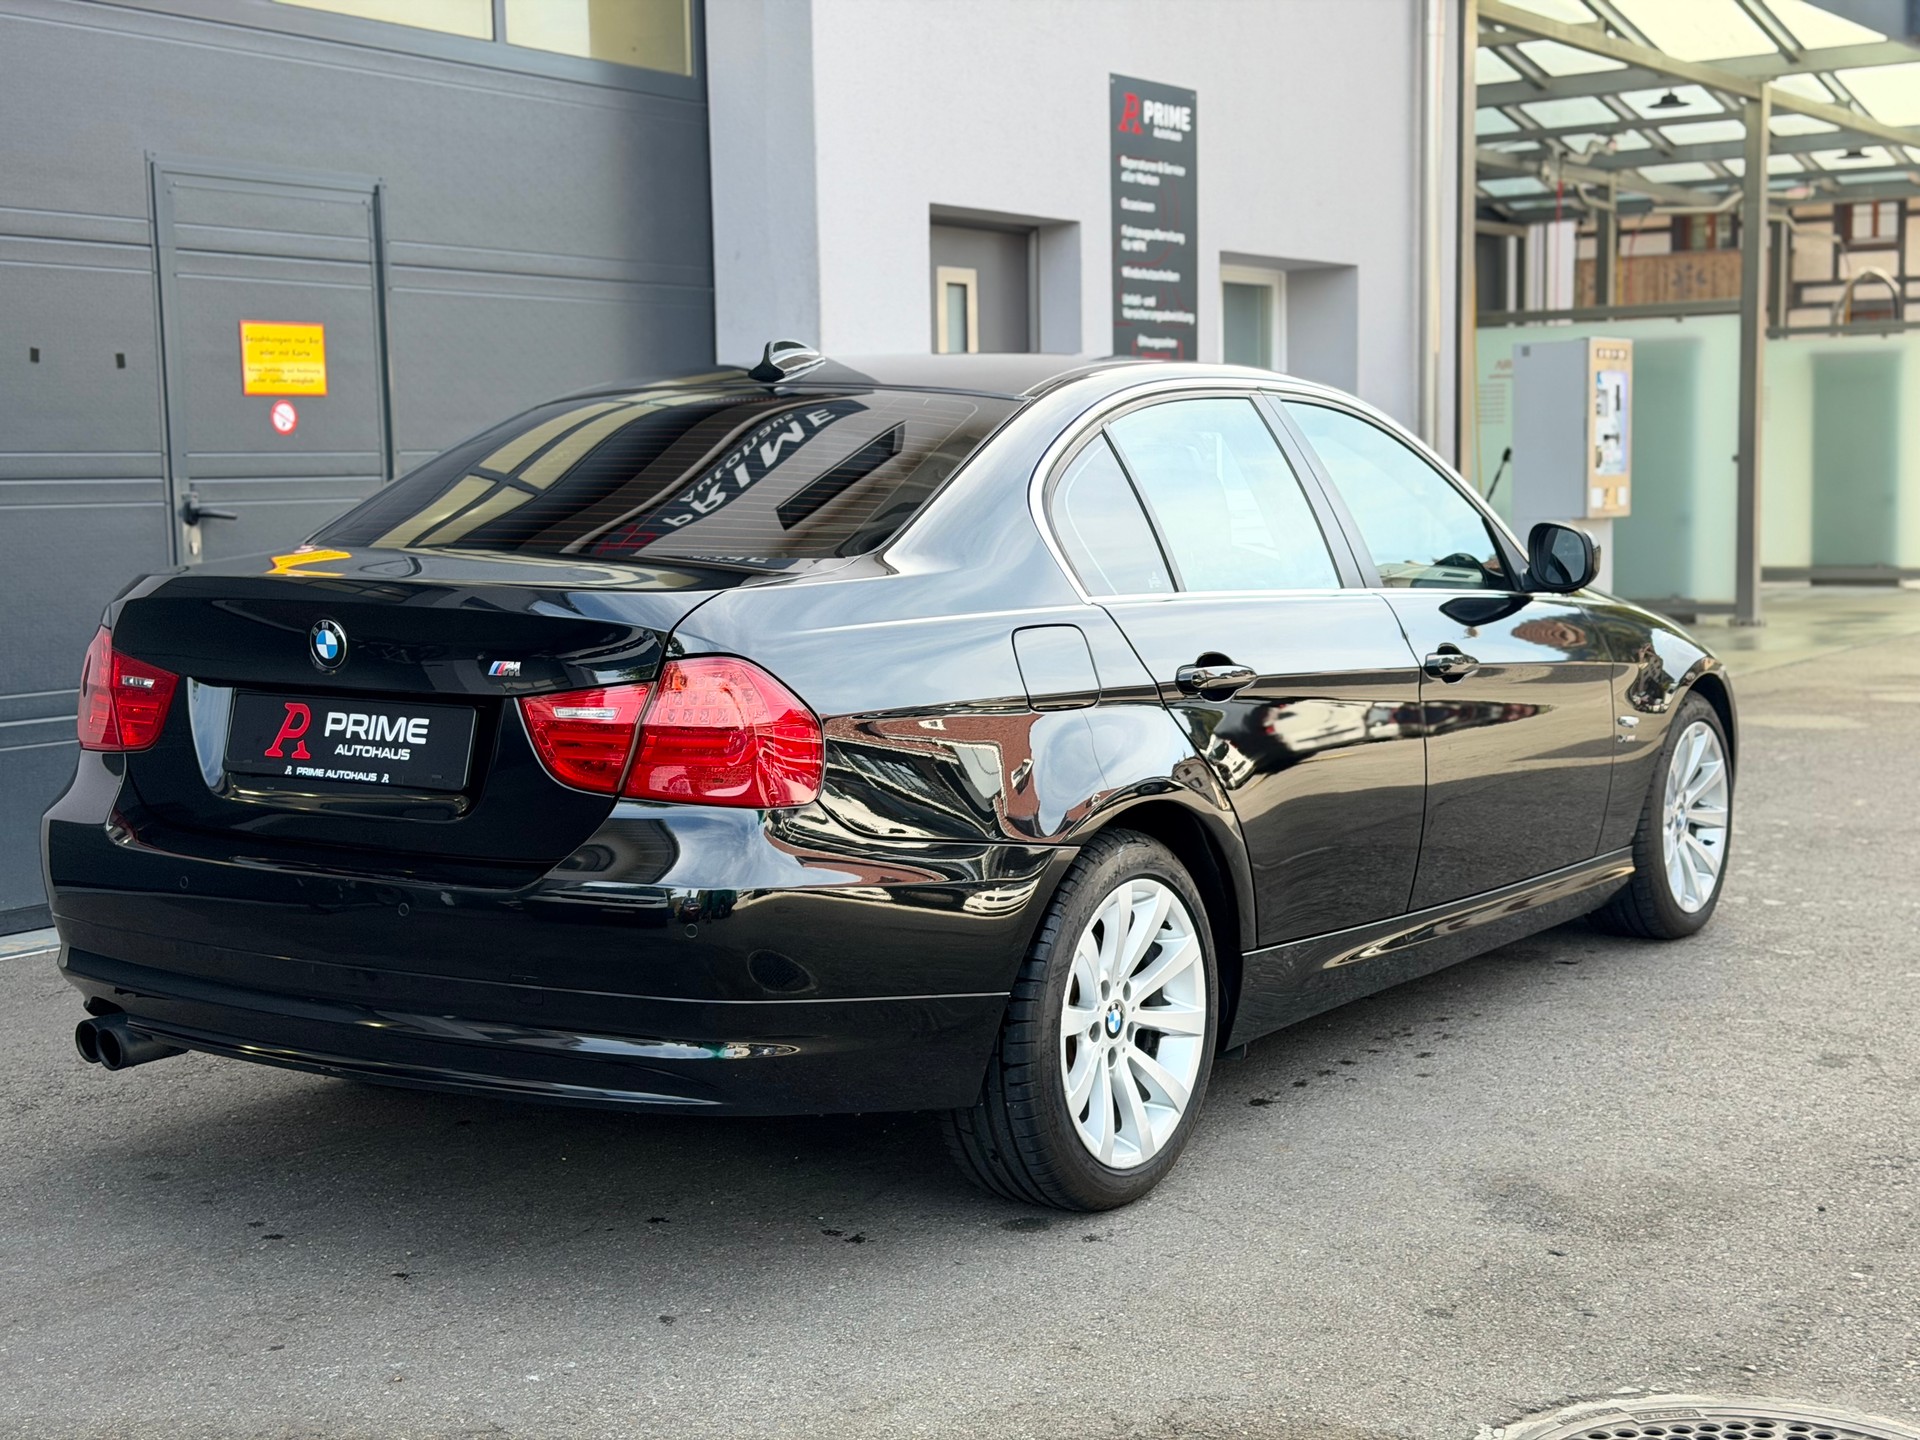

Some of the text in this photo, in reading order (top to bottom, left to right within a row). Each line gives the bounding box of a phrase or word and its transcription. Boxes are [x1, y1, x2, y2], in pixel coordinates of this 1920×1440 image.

[1143, 99, 1191, 132] PRIME
[324, 711, 430, 745] PRIME
[334, 744, 411, 761] AUTOHAUS
[296, 766, 325, 778] PRIME
[325, 769, 377, 782] AUTOHAUS
